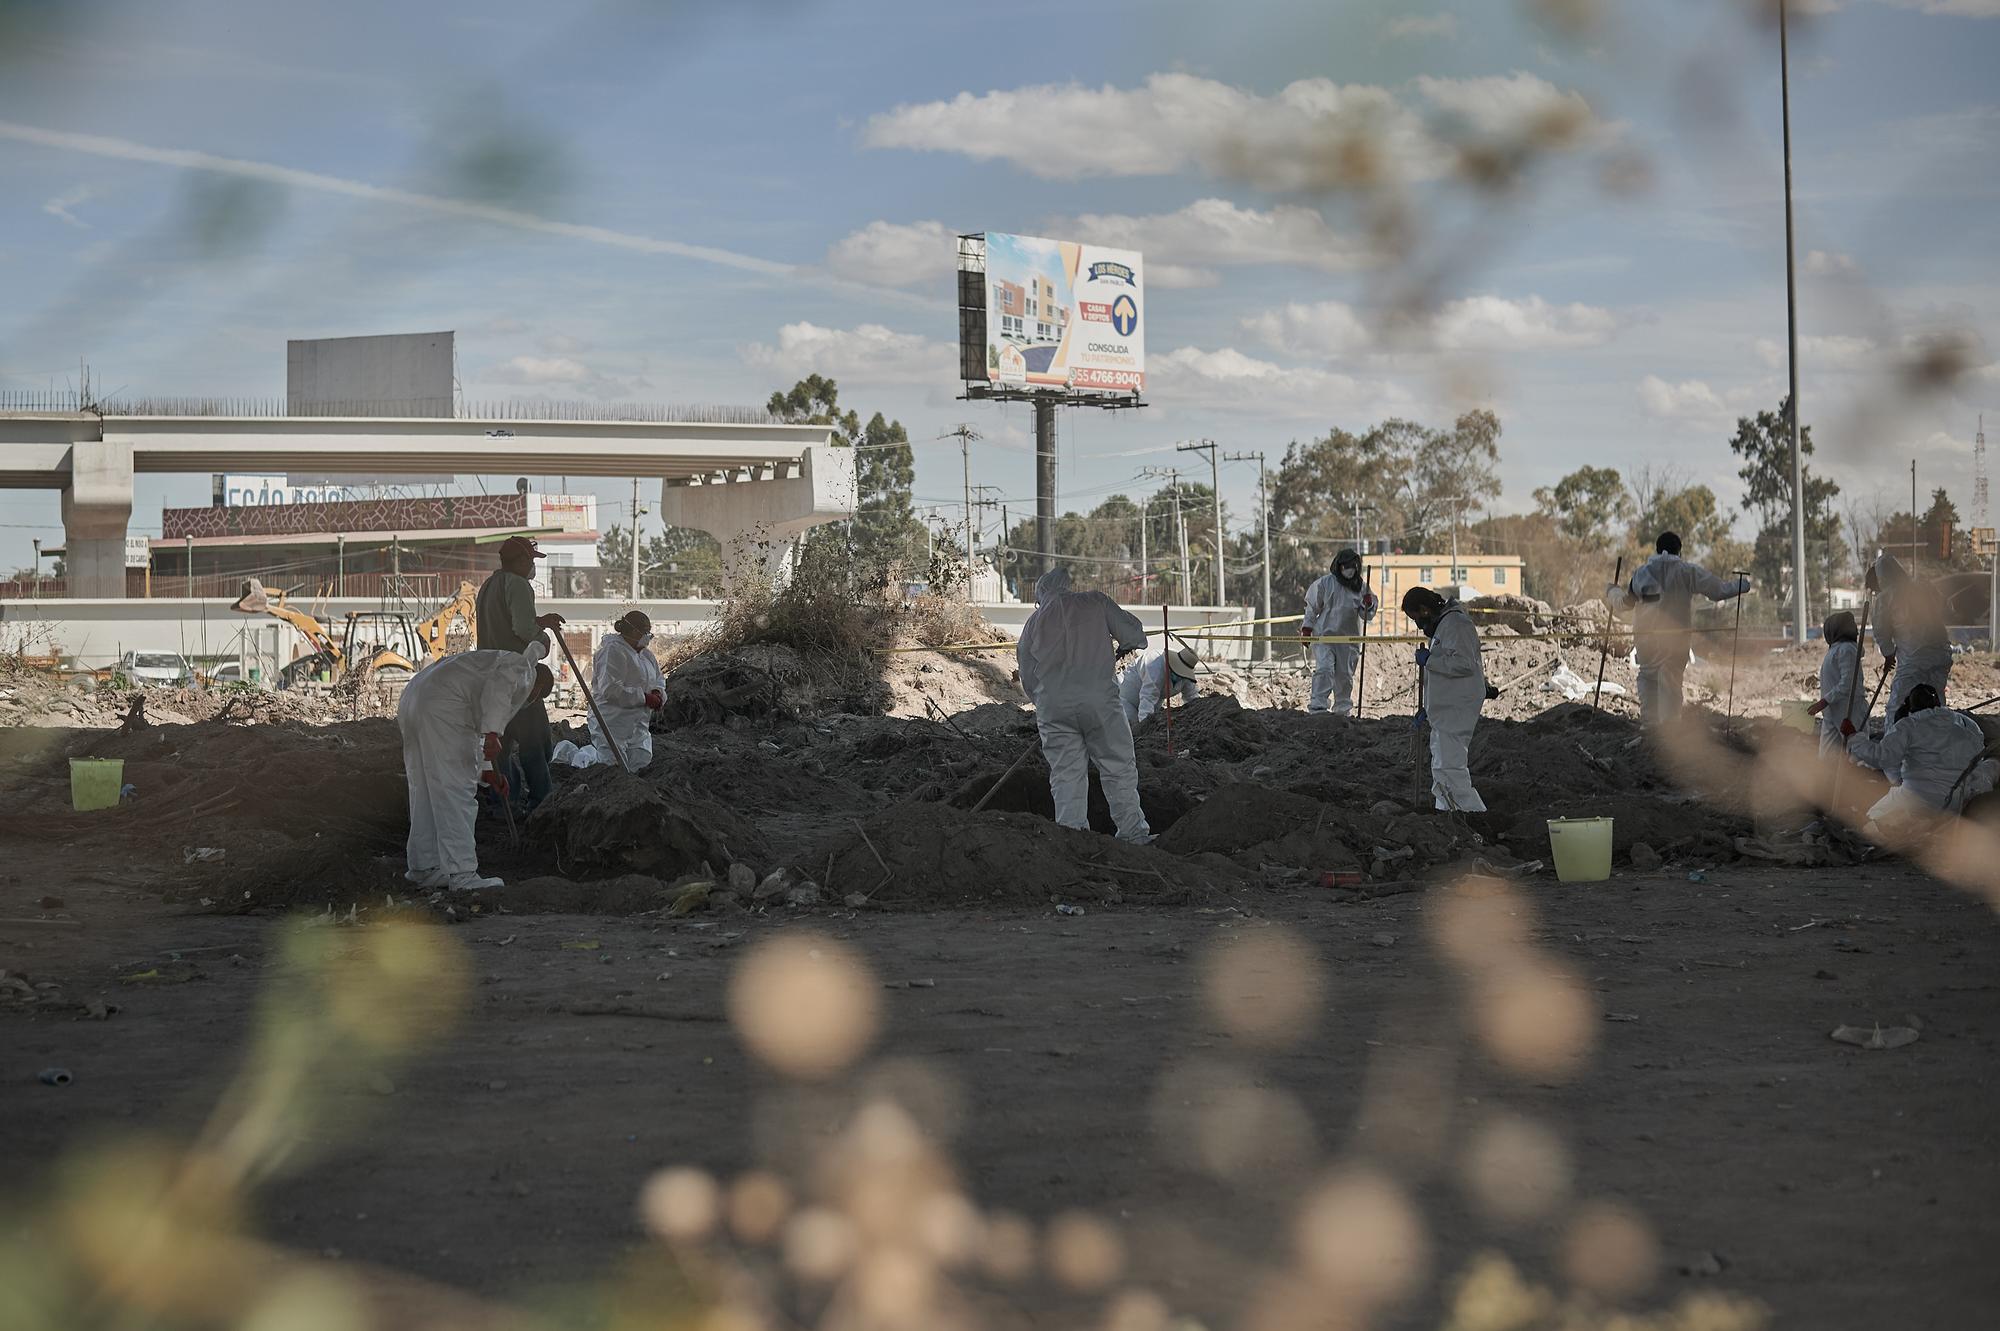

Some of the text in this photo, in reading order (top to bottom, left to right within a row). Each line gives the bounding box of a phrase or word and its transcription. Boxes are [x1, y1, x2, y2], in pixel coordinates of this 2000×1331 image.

[1087, 304, 1106, 313] CASAS
[1088, 343, 1129, 354] CONSOLIDA
[1077, 368, 1089, 382] 55
